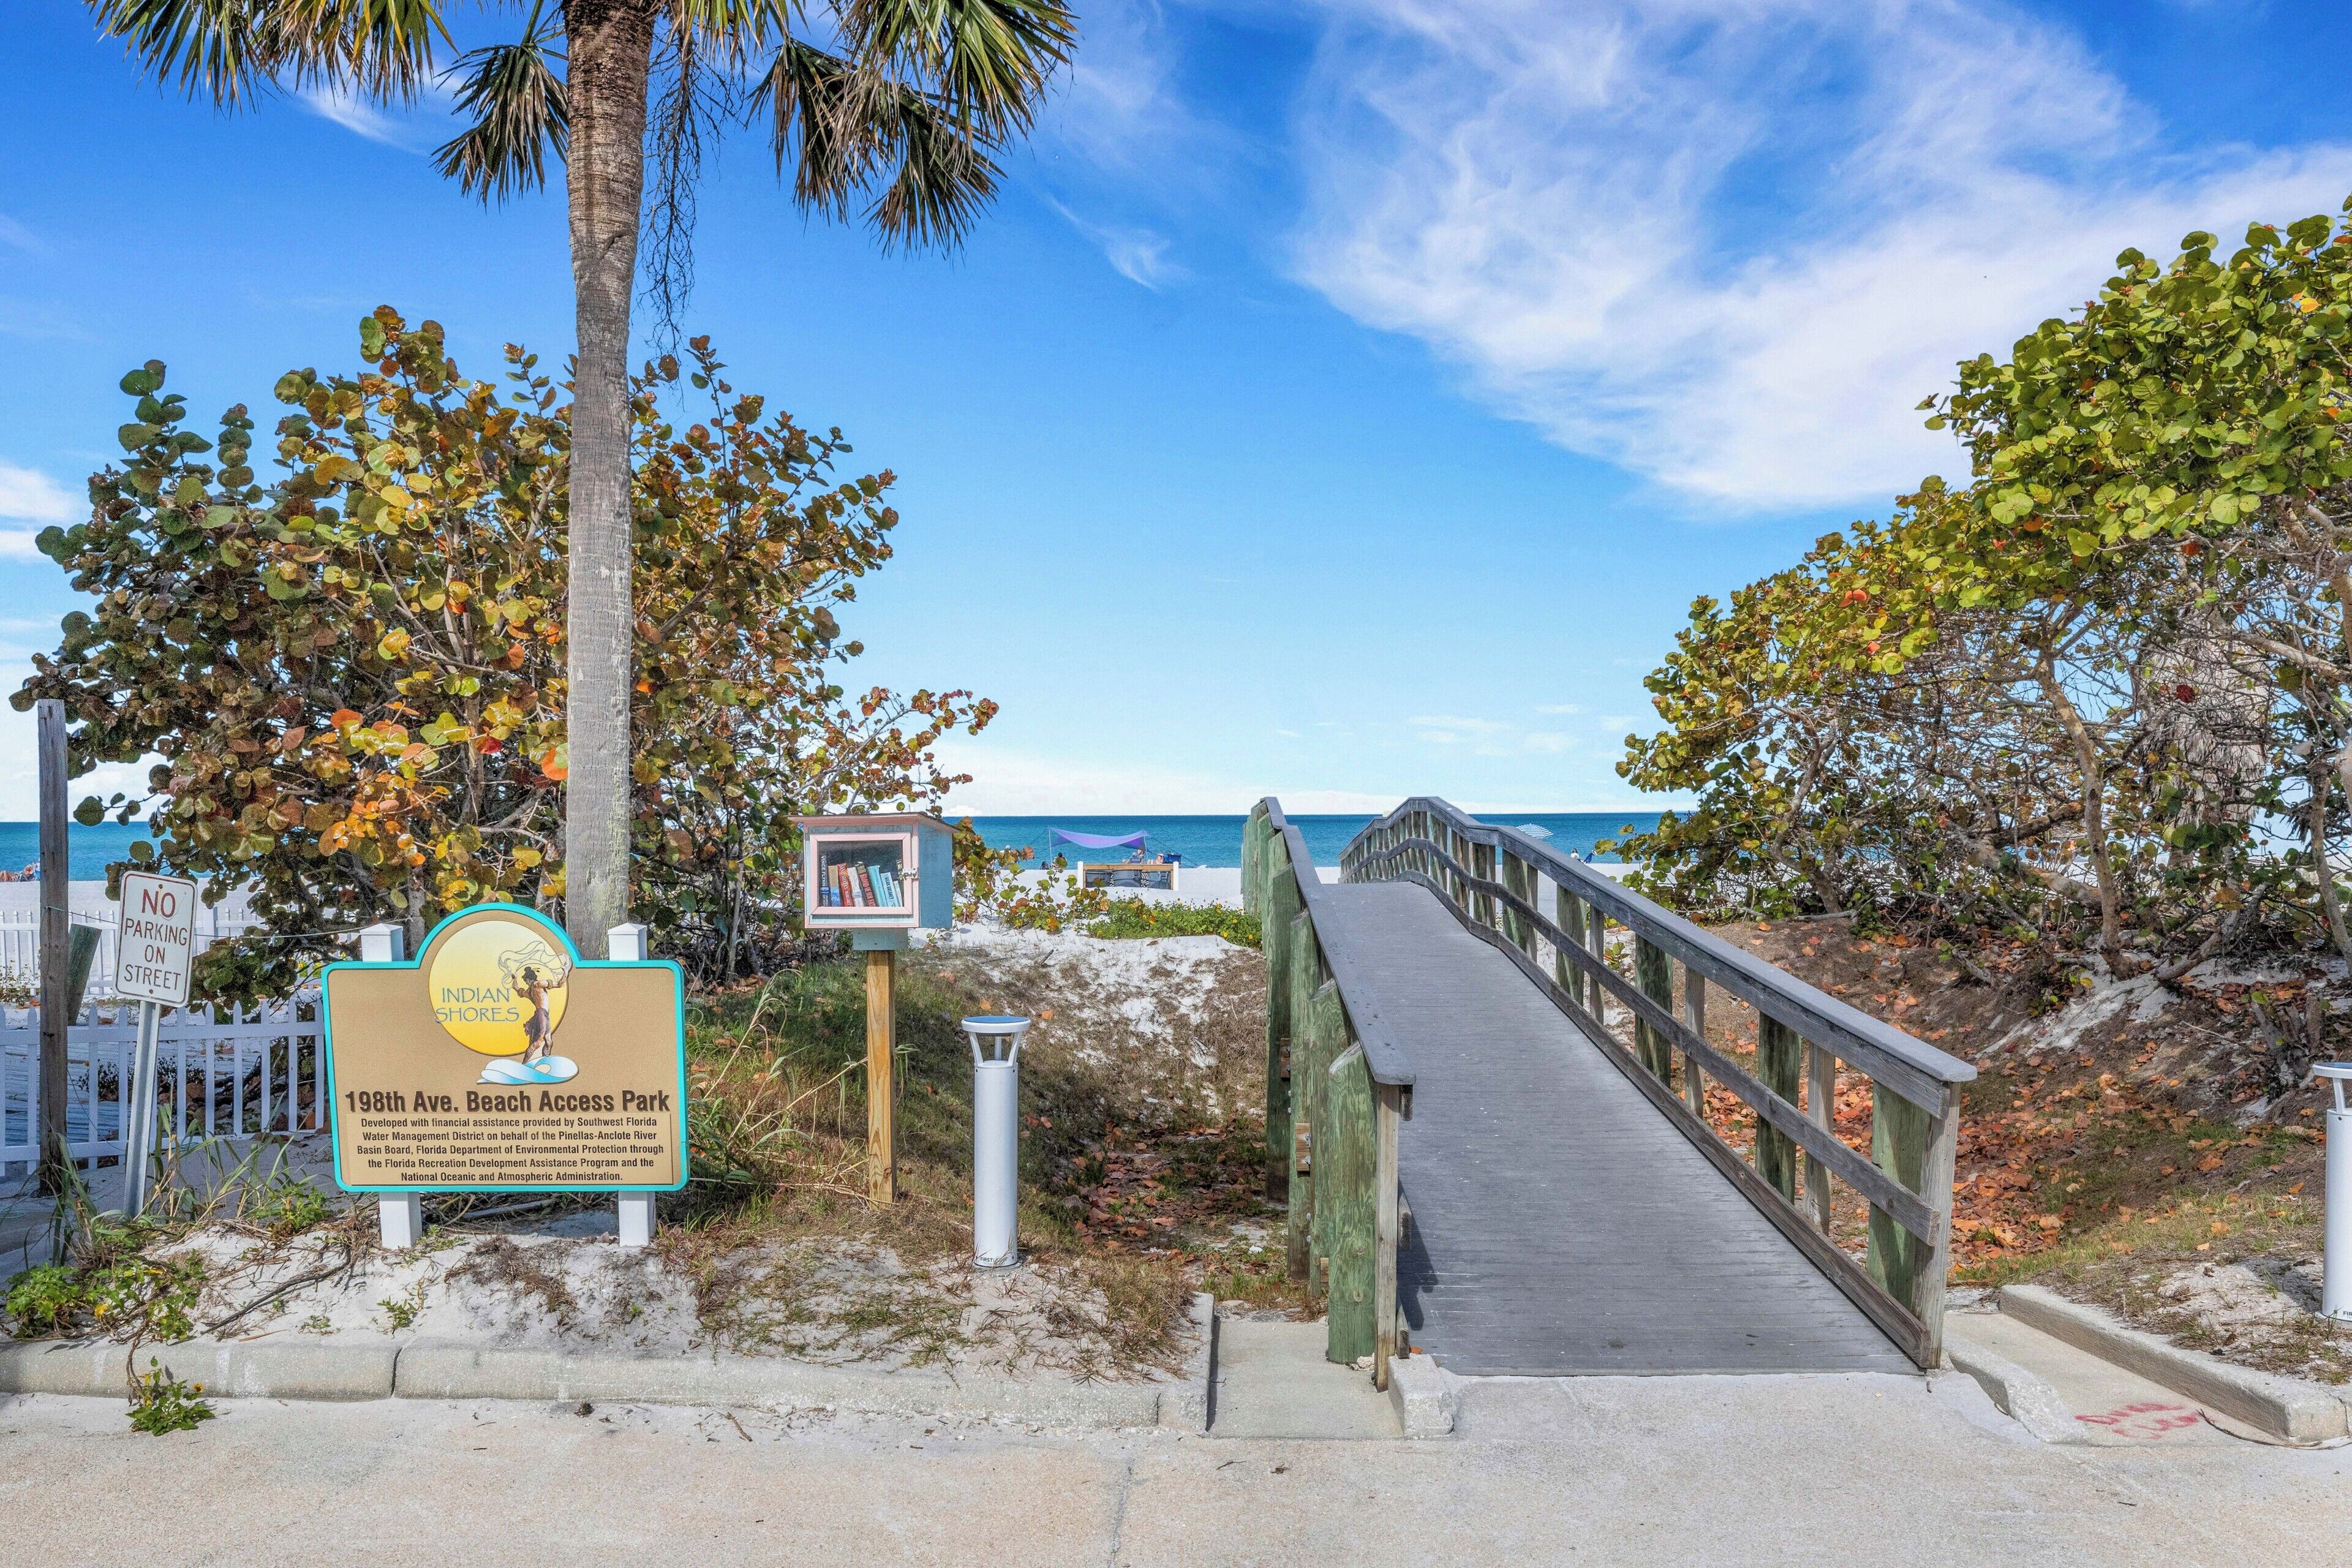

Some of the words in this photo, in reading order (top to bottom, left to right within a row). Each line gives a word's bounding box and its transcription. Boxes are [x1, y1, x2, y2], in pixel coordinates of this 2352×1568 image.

[141, 889, 176, 918] NO
[124, 918, 187, 946] PARKING
[145, 944, 165, 965] ON
[124, 964, 181, 990] STREET
[442, 987, 510, 1003] INDIAN
[434, 1007, 519, 1023] SHORES
[345, 1090, 406, 1112] 198th
[413, 1090, 459, 1112] Ave.
[466, 1090, 532, 1112] Beach
[538, 1090, 614, 1112] Access
[622, 1090, 671, 1112] Park
[361, 1118, 407, 1129] Developed
[410, 1118, 429, 1127] with
[431, 1118, 470, 1127] financial
[473, 1118, 520, 1127] assistance
[522, 1118, 561, 1128] provided
[564, 1118, 575, 1128] by
[577, 1117, 624, 1126] Southwest
[626, 1117, 657, 1126] Florida
[362, 1132, 389, 1141] Water
[392, 1132, 450, 1143] Management
[452, 1131, 484, 1140] District
[500, 1131, 528, 1140] behalf
[530, 1131, 540, 1140] of
[541, 1131, 556, 1140] the
[559, 1131, 631, 1140] Pinellas-Anclote
[633, 1131, 657, 1140] River
[357, 1145, 382, 1155] Basin
[385, 1145, 413, 1156] Board,
[417, 1145, 447, 1154] Florida
[450, 1145, 502, 1156] Department
[504, 1145, 513, 1154] of
[516, 1145, 579, 1154] Environmental
[582, 1144, 627, 1153] Protection
[630, 1144, 664, 1155] through
[368, 1159, 382, 1168] the
[385, 1159, 416, 1168] Florida
[418, 1159, 467, 1167] Recreation
[469, 1158, 527, 1169] Development
[529, 1158, 578, 1167] Assistance
[580, 1158, 619, 1169] Program
[621, 1158, 638, 1167] and
[640, 1158, 654, 1167] the
[401, 1172, 438, 1182] National
[440, 1172, 476, 1181] Oceanic
[478, 1172, 494, 1181] and
[497, 1172, 553, 1183] Atmospheric
[556, 1171, 623, 1181] Administration.
